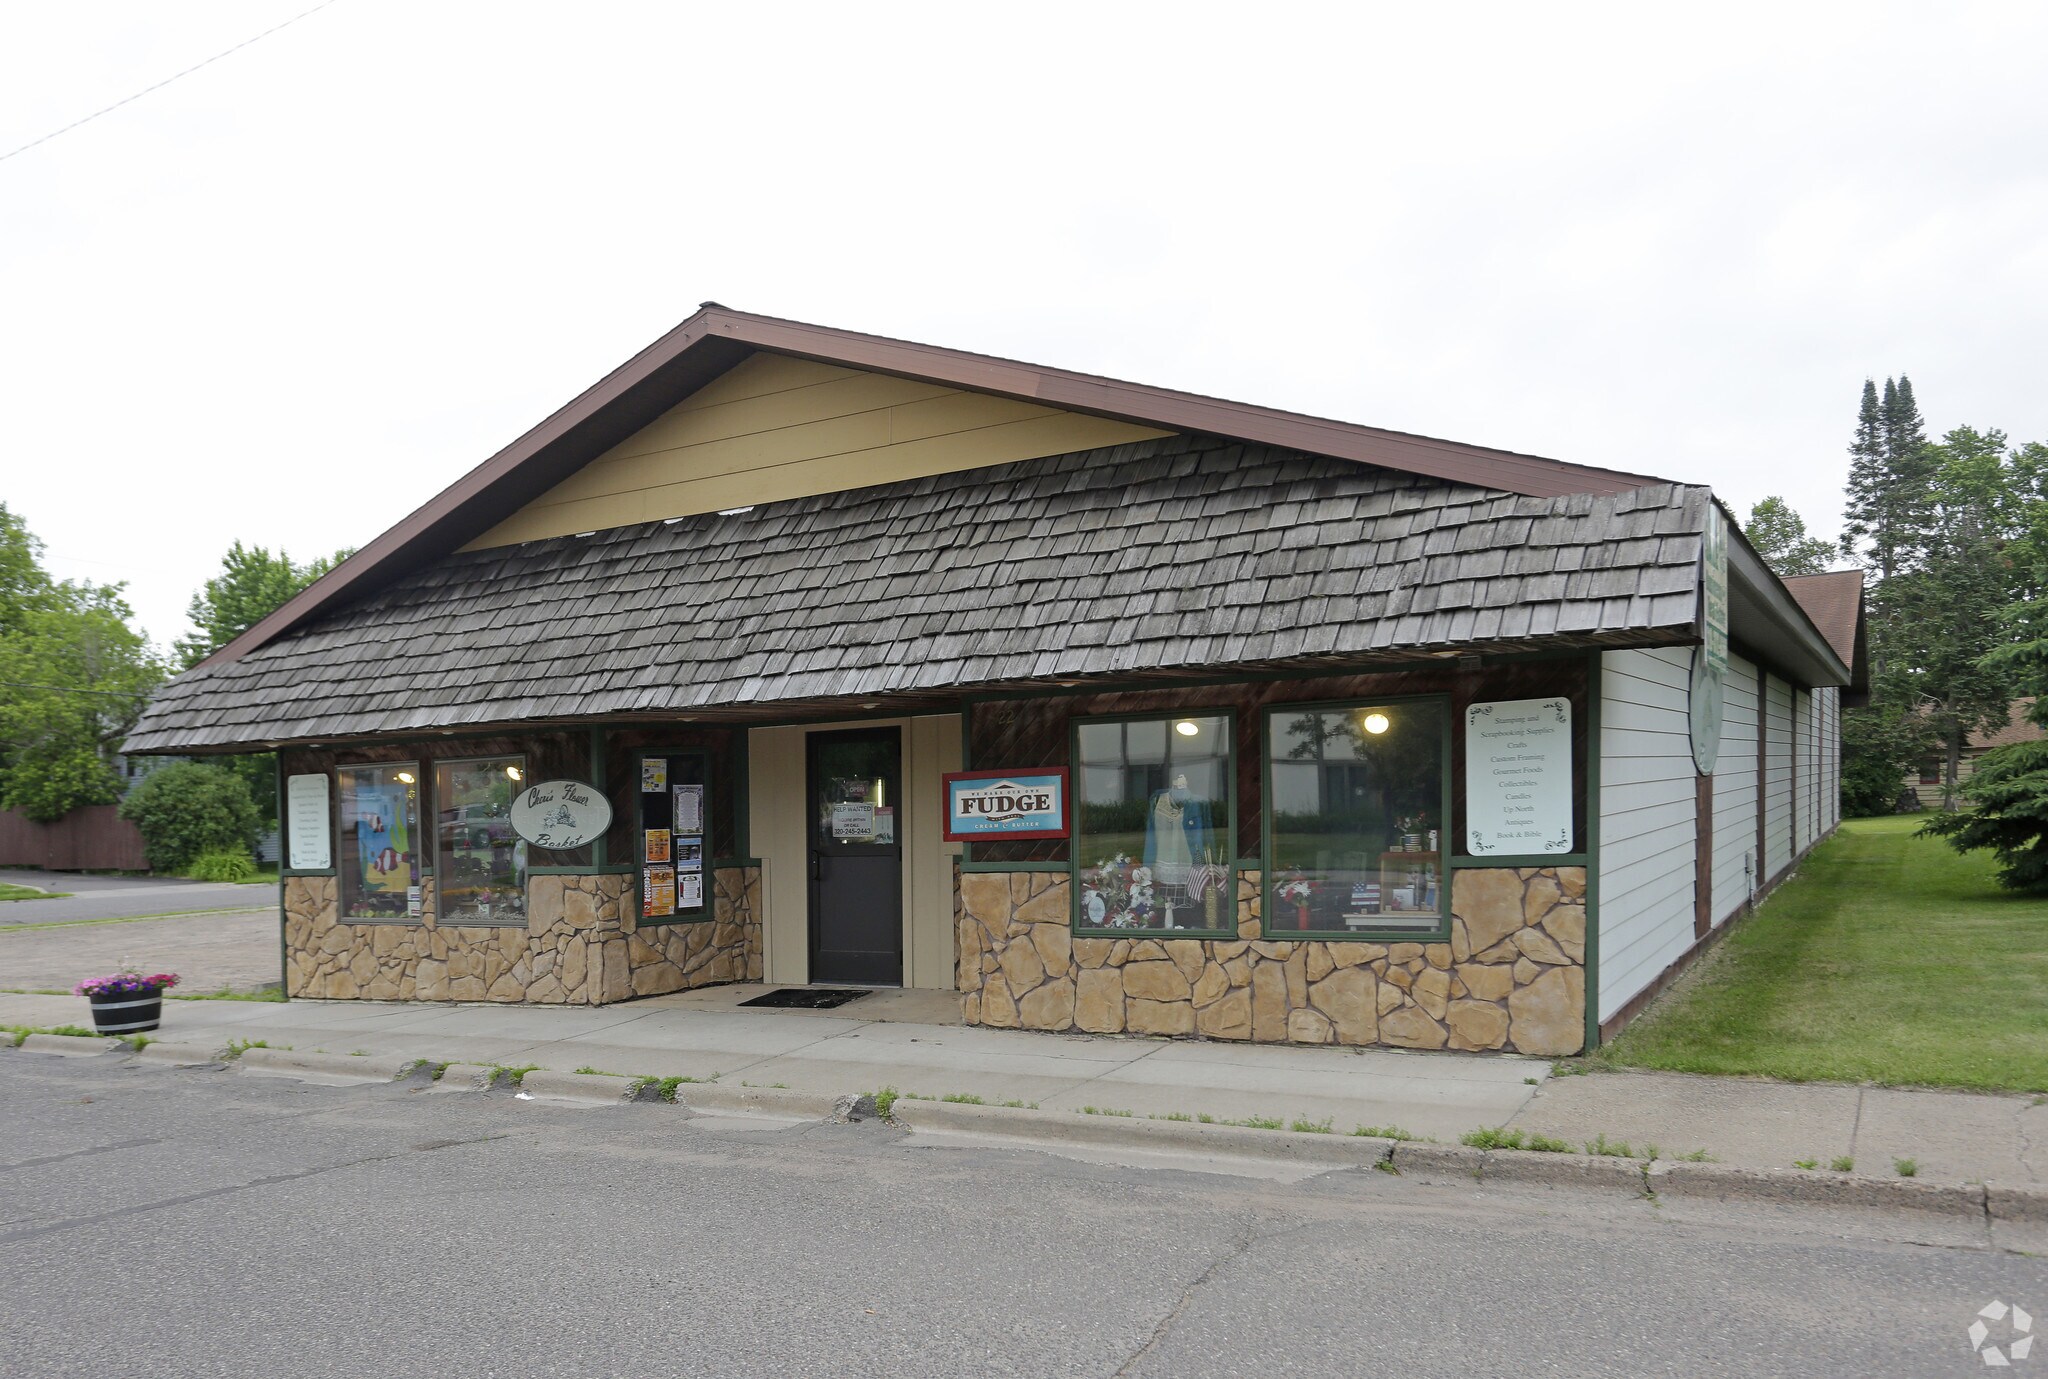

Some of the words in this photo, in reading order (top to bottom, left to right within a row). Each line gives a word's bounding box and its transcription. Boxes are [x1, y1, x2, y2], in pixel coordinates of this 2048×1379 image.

[1495, 716, 1526, 725] Stamping
[1527, 714, 1540, 722] and
[1480, 729, 1526, 739] Scrapbooking
[1526, 727, 1555, 735] Supplies
[1517, 754, 1545, 762] Framing
[1492, 768, 1522, 776] Gourmet
[1523, 766, 1544, 774] Foods
[562, 782, 589, 807] Flower
[961, 794, 1050, 814] FUDGE
[1503, 806, 1514, 814] Up
[1504, 818, 1534, 827] Antiques
[534, 833, 584, 848] Basket
